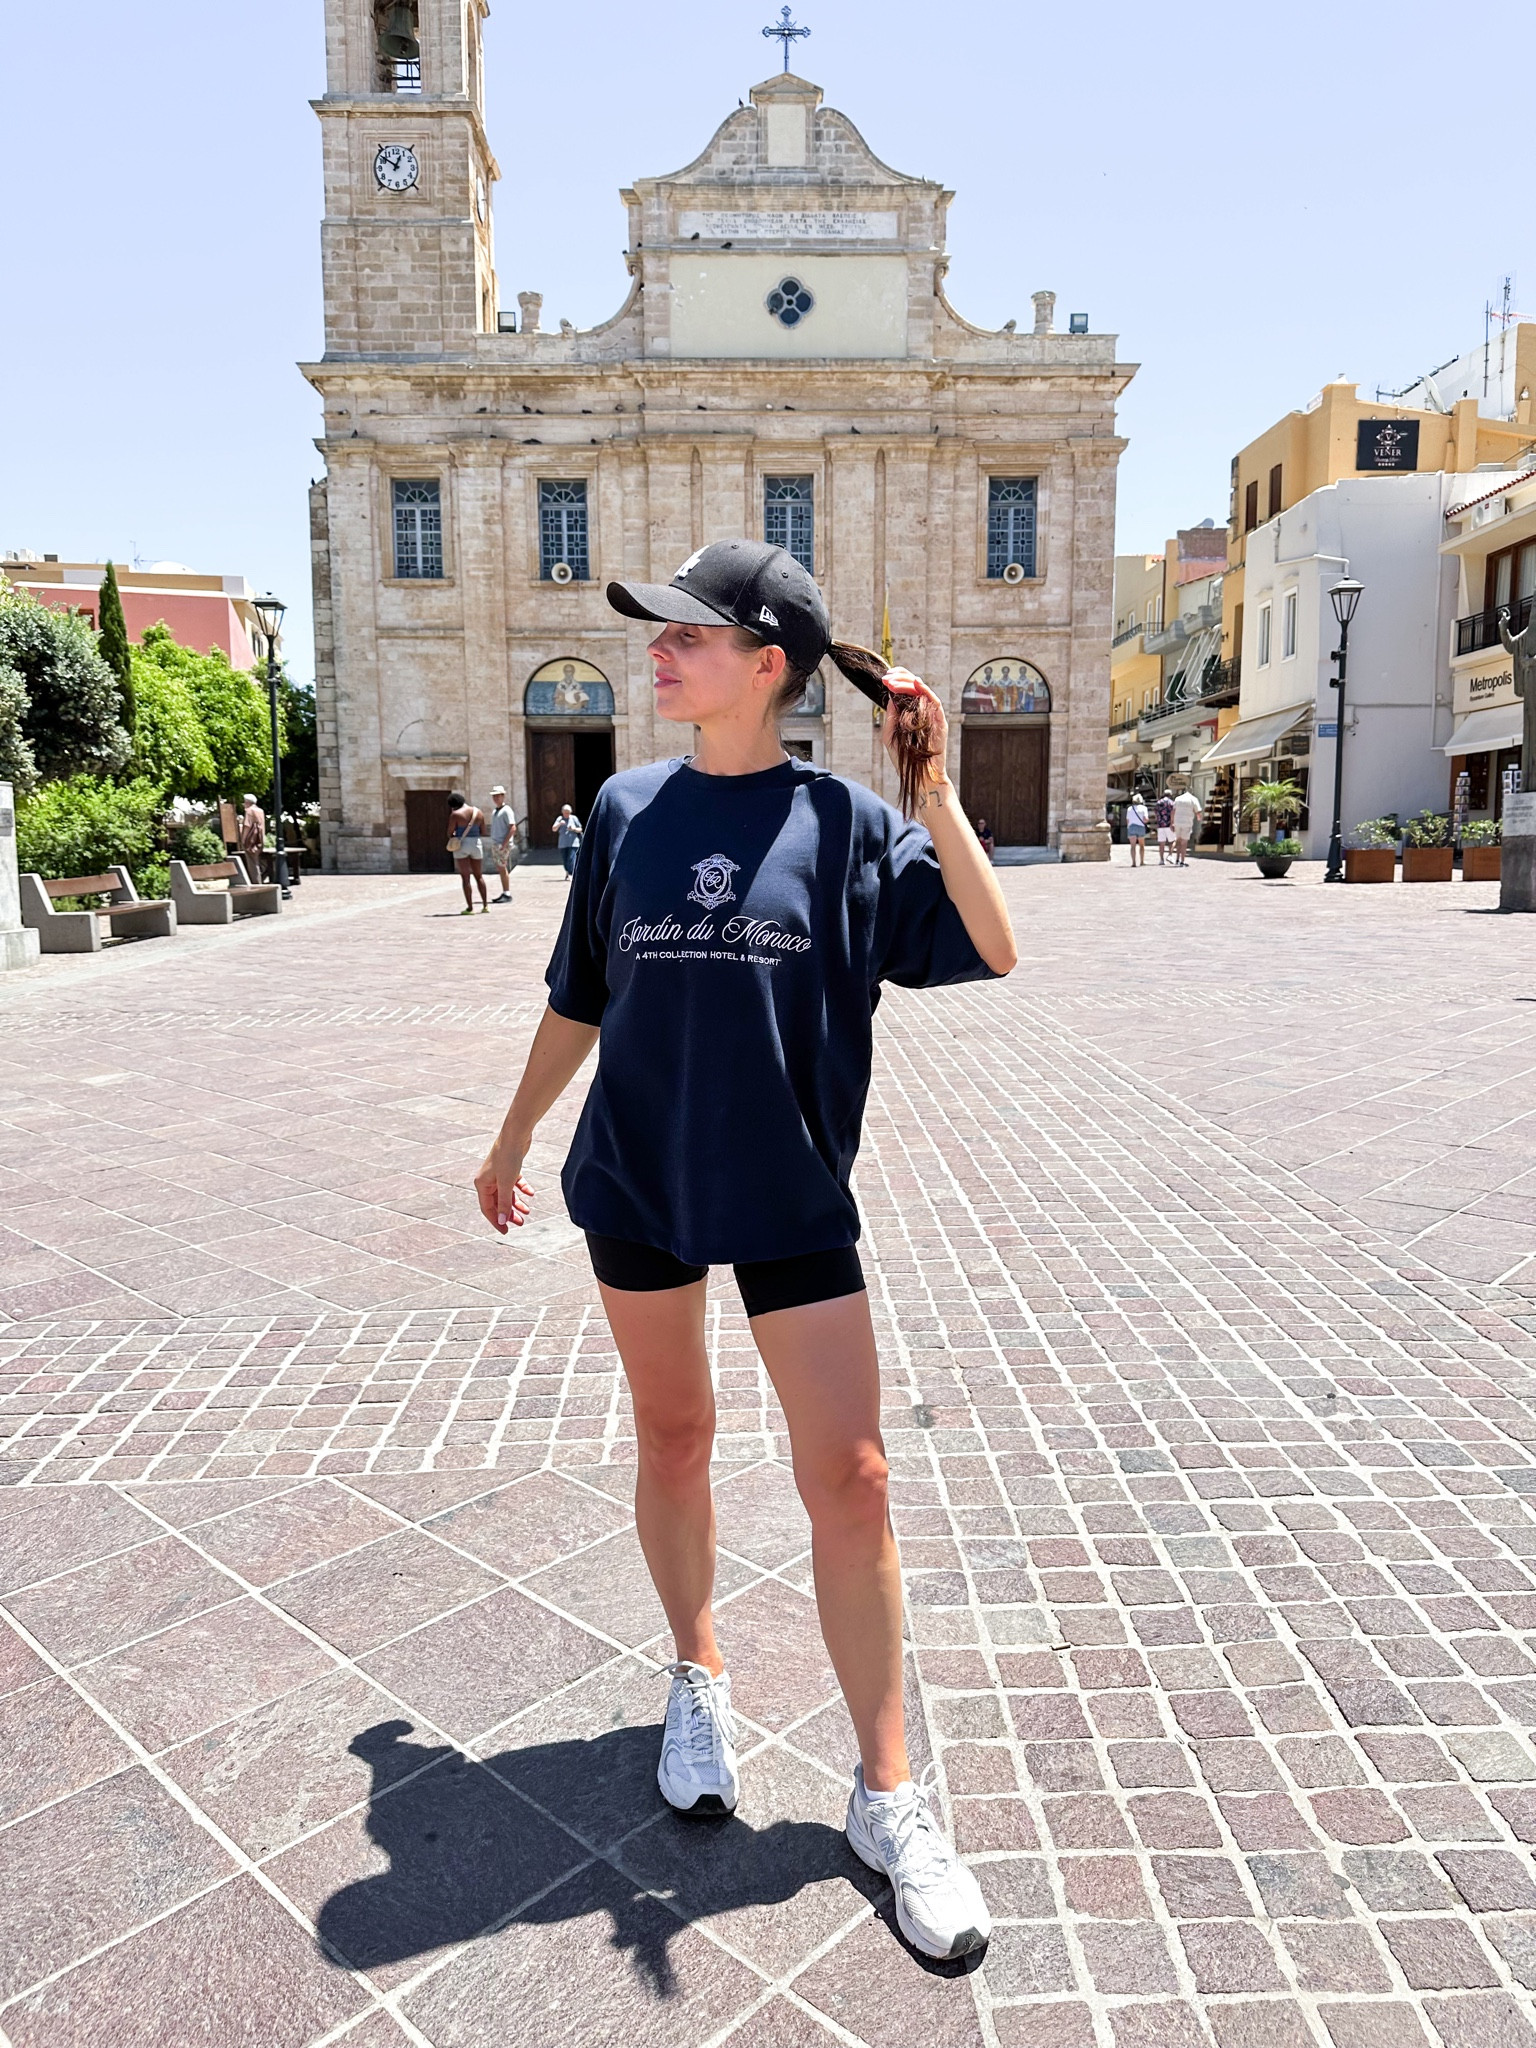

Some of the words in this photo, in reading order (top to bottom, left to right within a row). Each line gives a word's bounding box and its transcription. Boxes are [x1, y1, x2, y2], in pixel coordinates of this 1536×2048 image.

[387, 179, 392, 187] 7
[1470, 670, 1512, 692] Metropolis
[619, 914, 683, 952] Jardin
[687, 914, 715, 940] du
[722, 915, 812, 953] Monaco
[635, 952, 641, 960] A
[642, 951, 658, 960] 4TH
[659, 950, 708, 959] COLLECTION
[710, 951, 739, 961] HOTEL
[740, 954, 746, 962] &
[747, 954, 781, 966] RESORT
